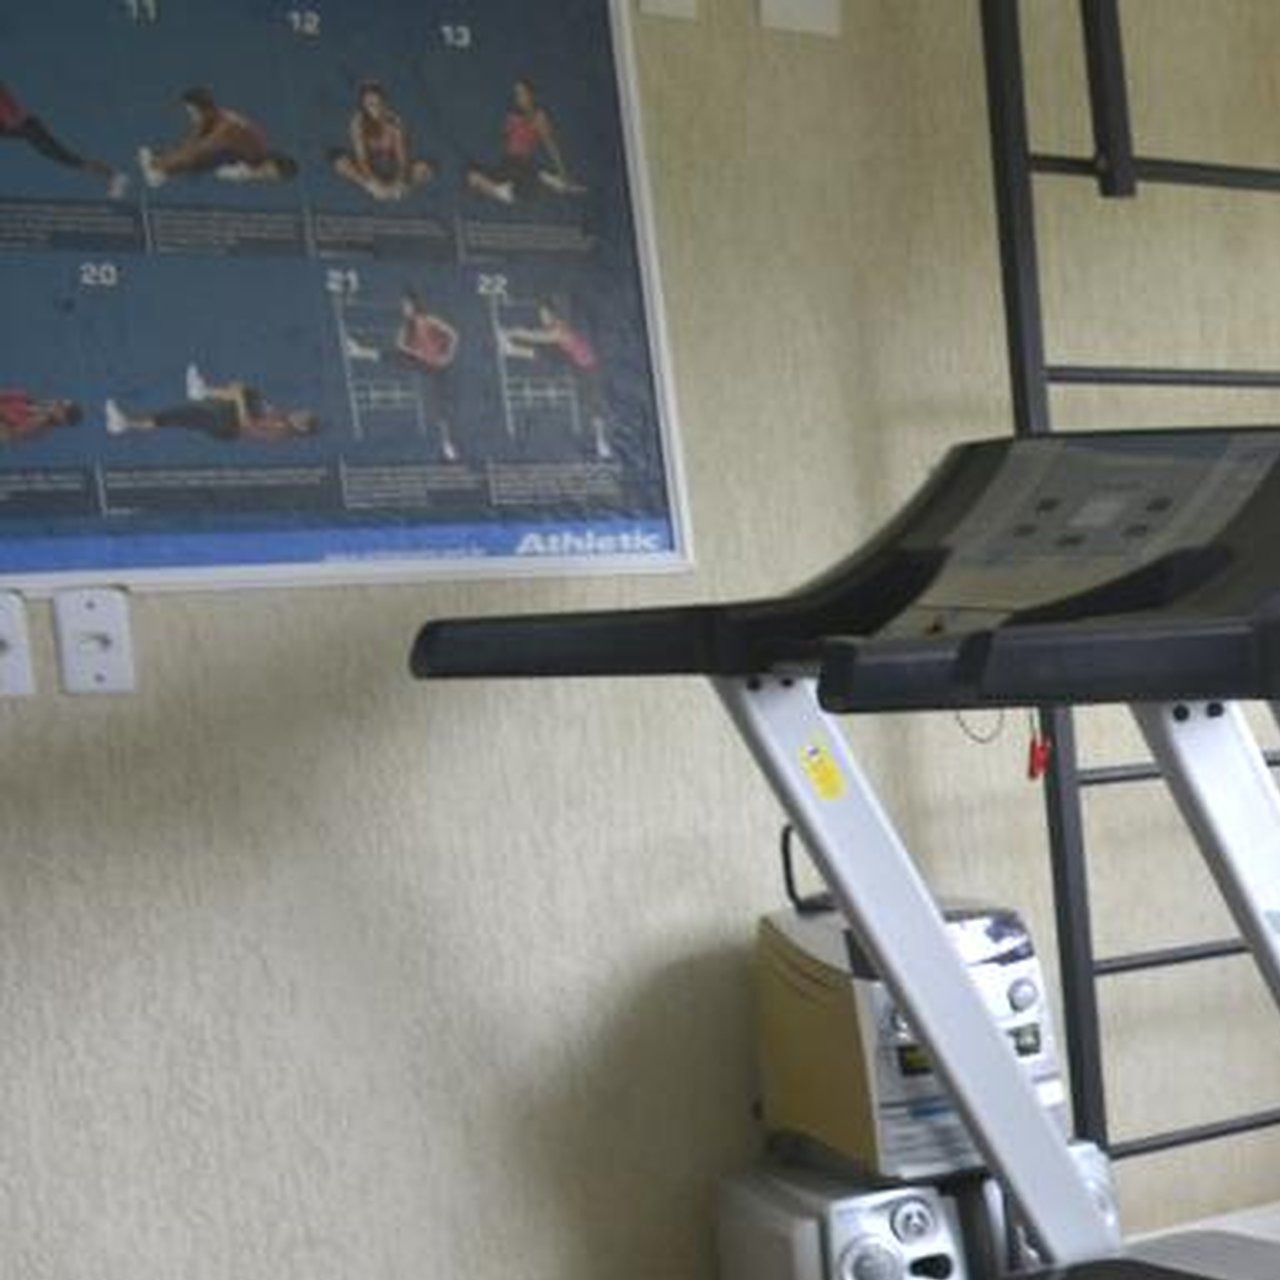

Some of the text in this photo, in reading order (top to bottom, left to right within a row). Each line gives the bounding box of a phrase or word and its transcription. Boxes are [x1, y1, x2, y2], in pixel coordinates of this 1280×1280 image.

[287, 10, 320, 35] 12
[441, 24, 471, 47] 13
[79, 262, 118, 286] 20
[326, 268, 359, 292] 21
[478, 273, 508, 294] 22
